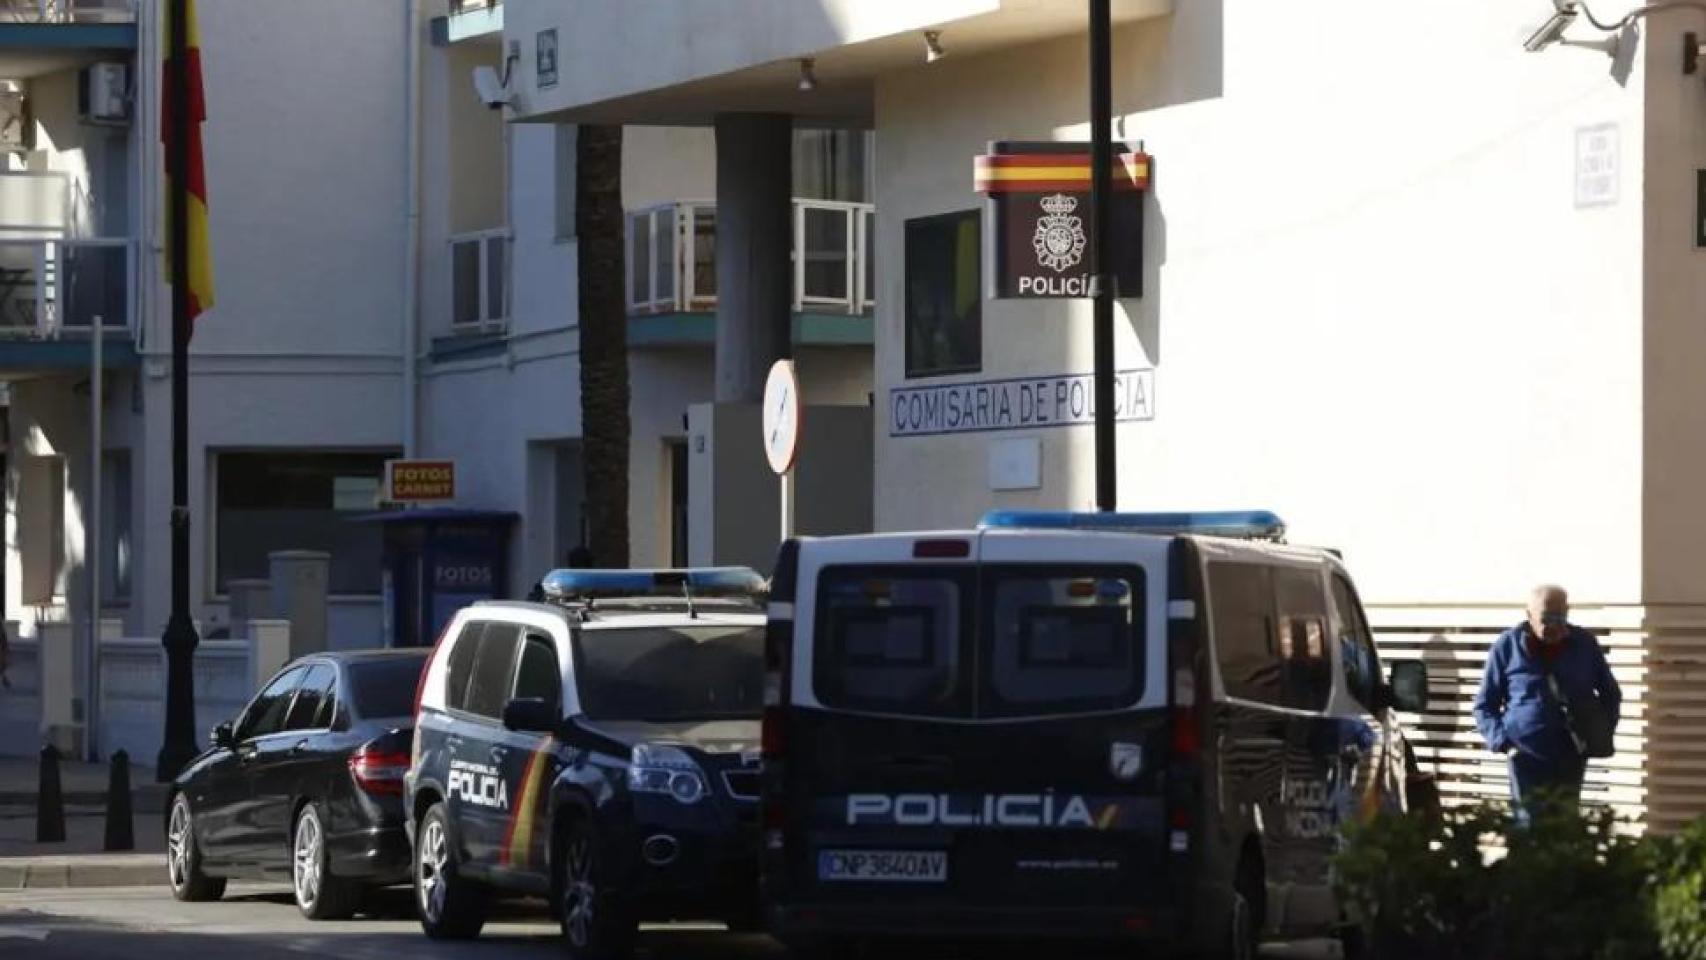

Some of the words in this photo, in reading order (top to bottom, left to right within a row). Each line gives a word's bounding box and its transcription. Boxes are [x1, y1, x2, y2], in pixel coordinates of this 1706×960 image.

[894, 387, 1011, 430] COMISARIA
[1020, 383, 1048, 423] DE
[1055, 376, 1149, 420] POLCIA
[394, 467, 451, 481] FOTOS
[434, 565, 492, 584] FOTOS
[846, 787, 1094, 826] POLICÍA
